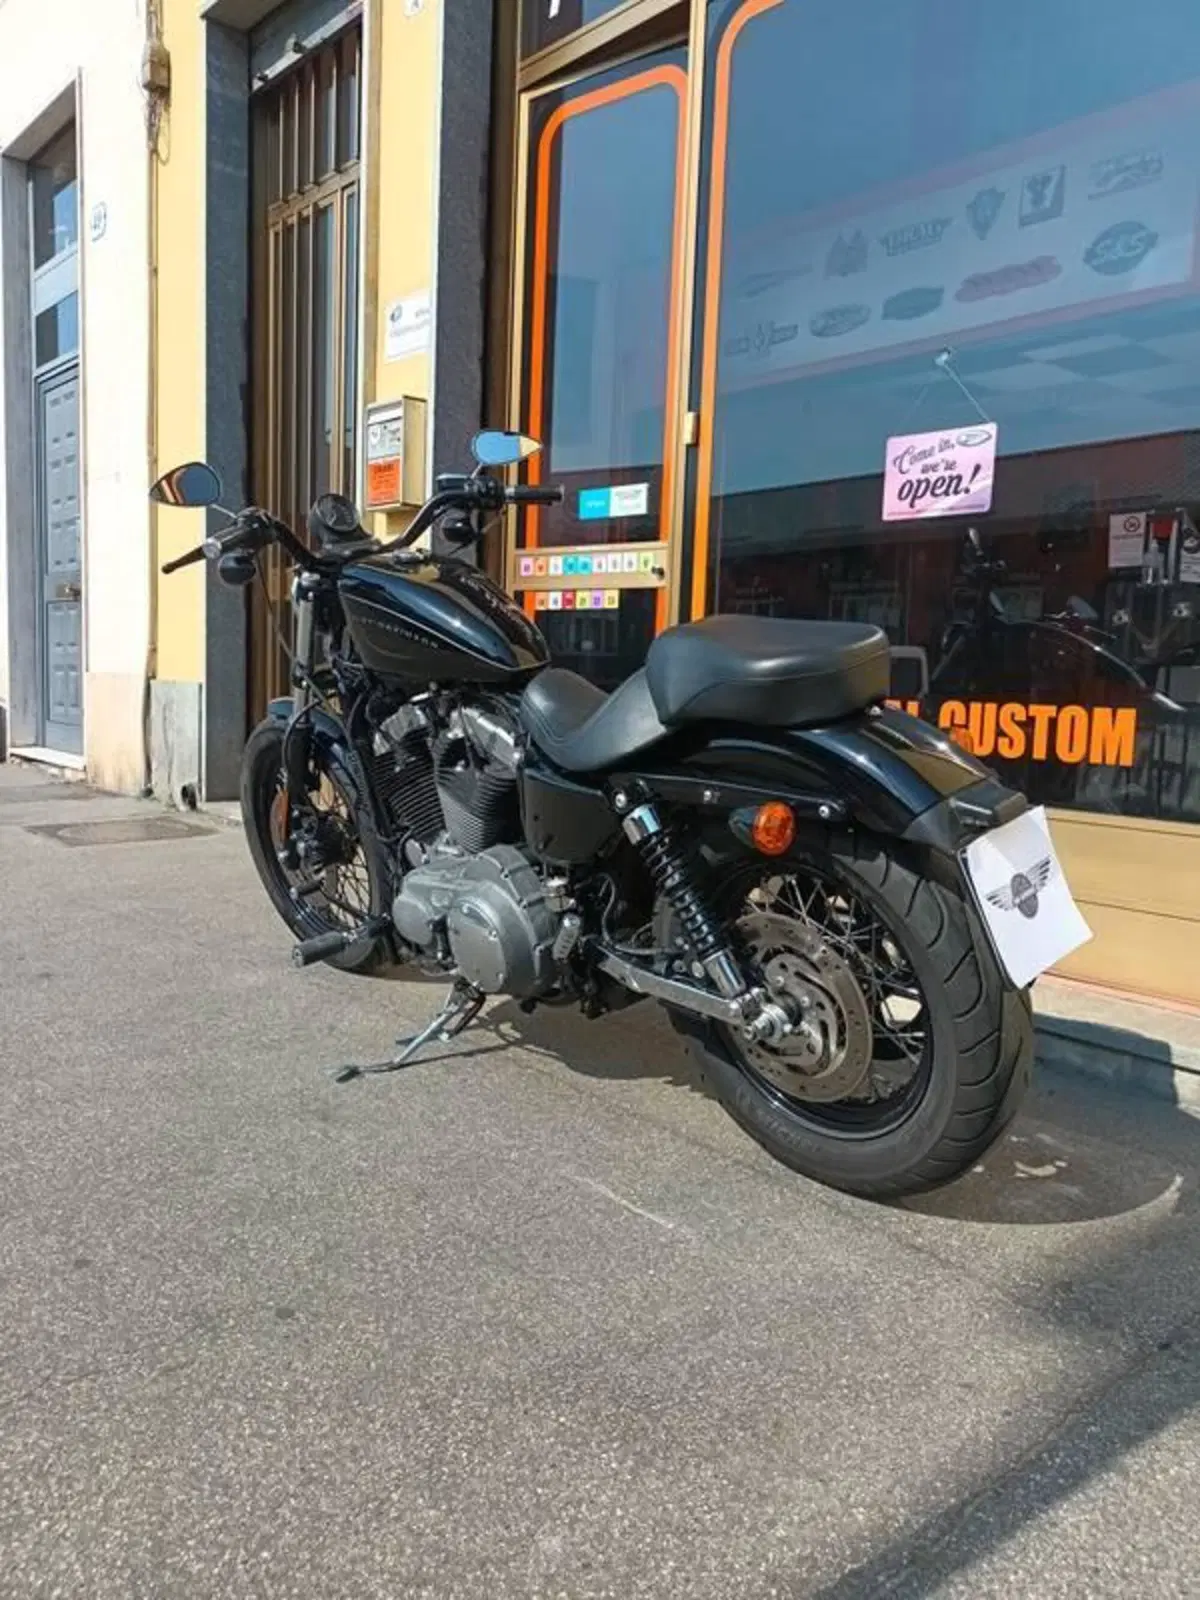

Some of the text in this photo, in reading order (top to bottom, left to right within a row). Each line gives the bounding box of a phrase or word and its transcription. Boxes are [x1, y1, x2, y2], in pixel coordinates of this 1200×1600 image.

[893, 444, 936, 475] Come
[897, 463, 982, 509] open!
[938, 700, 1136, 768] CUSTOM
